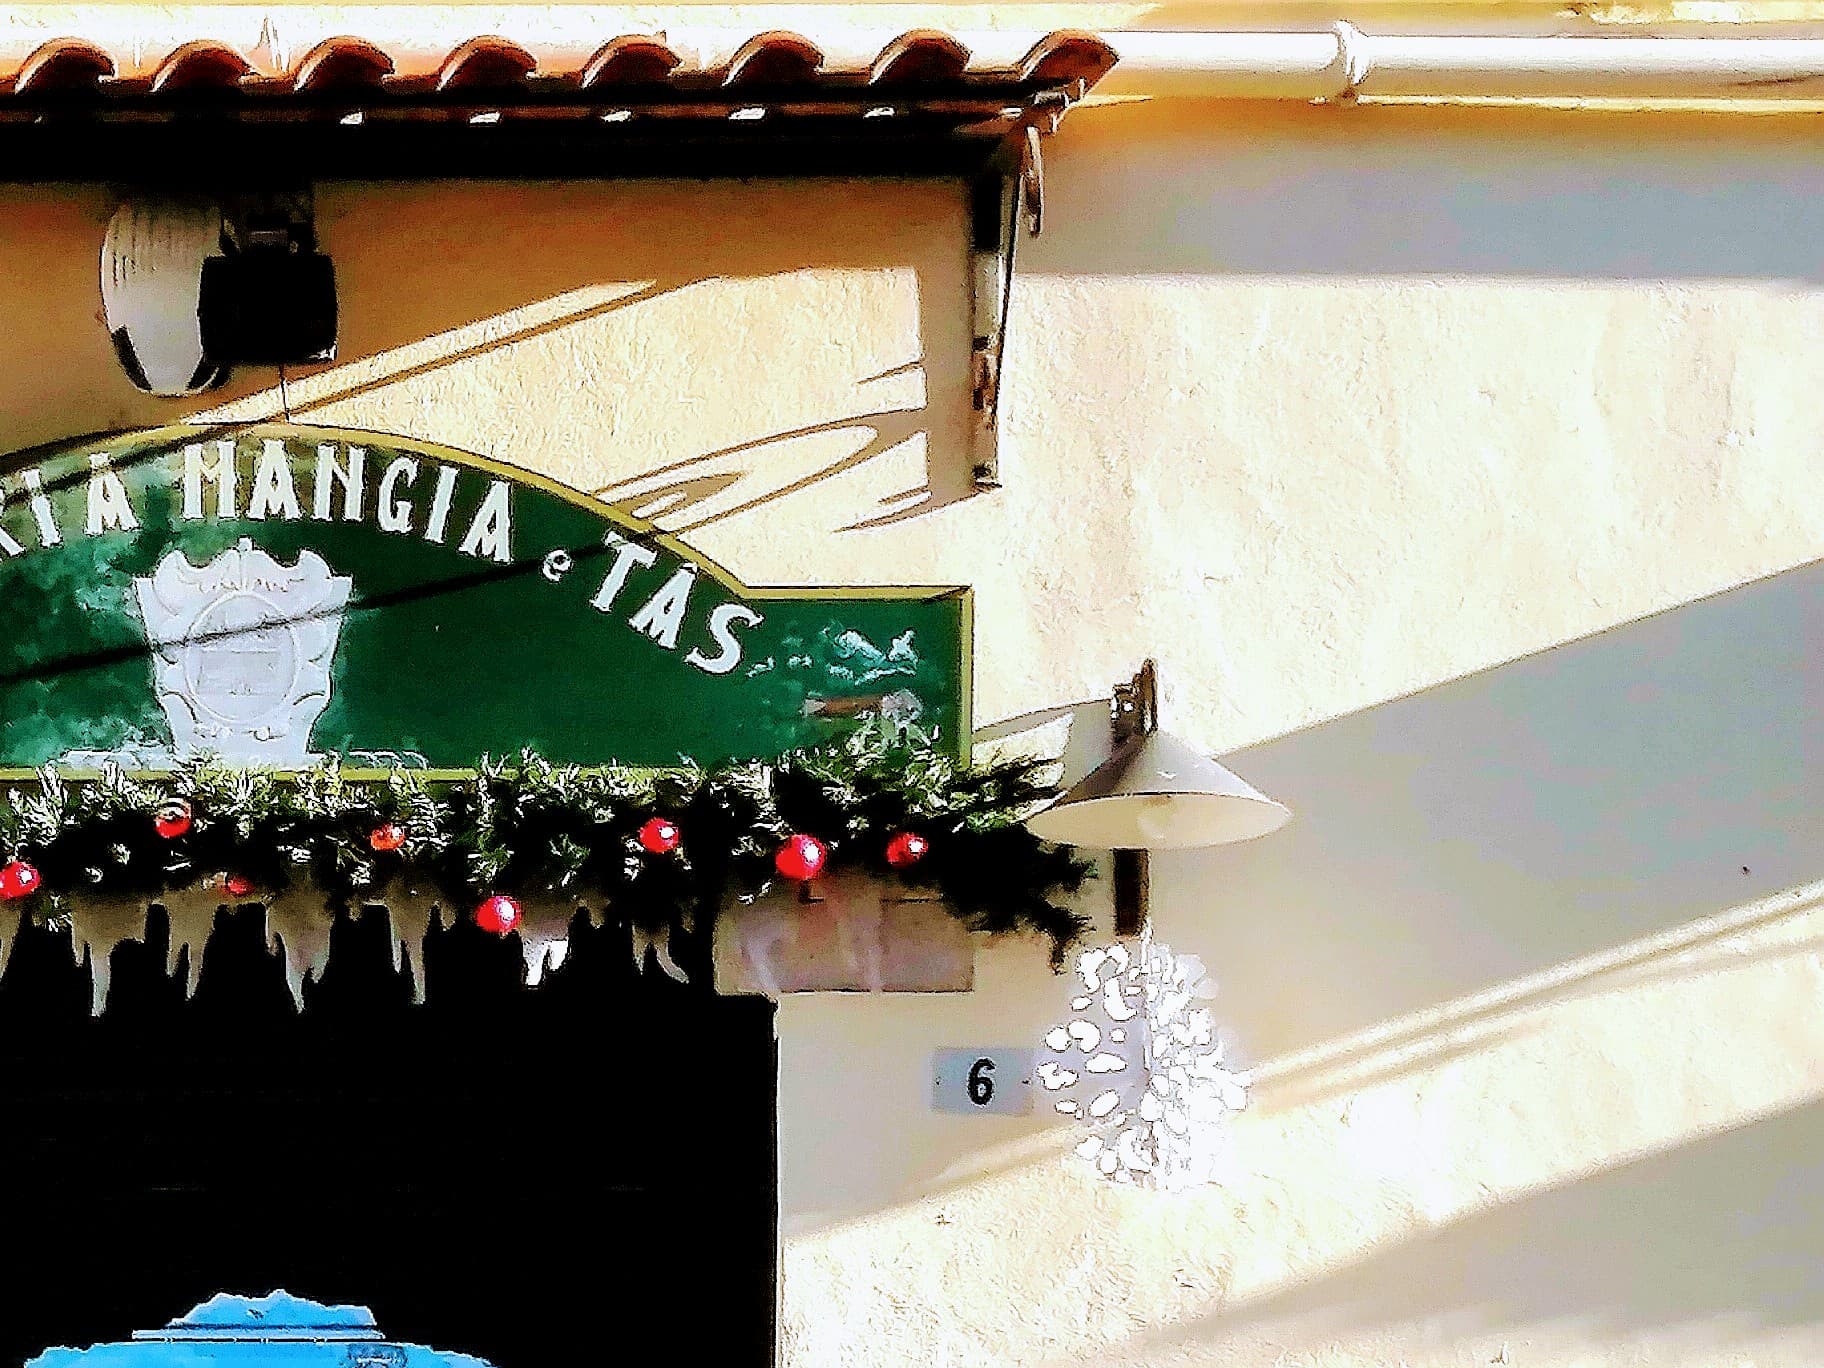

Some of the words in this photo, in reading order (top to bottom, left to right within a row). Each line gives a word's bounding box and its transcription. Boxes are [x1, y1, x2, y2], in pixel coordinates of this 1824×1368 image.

[182, 439, 512, 563] MANGIA
[542, 549, 573, 582] e
[967, 1057, 997, 1106] 6
